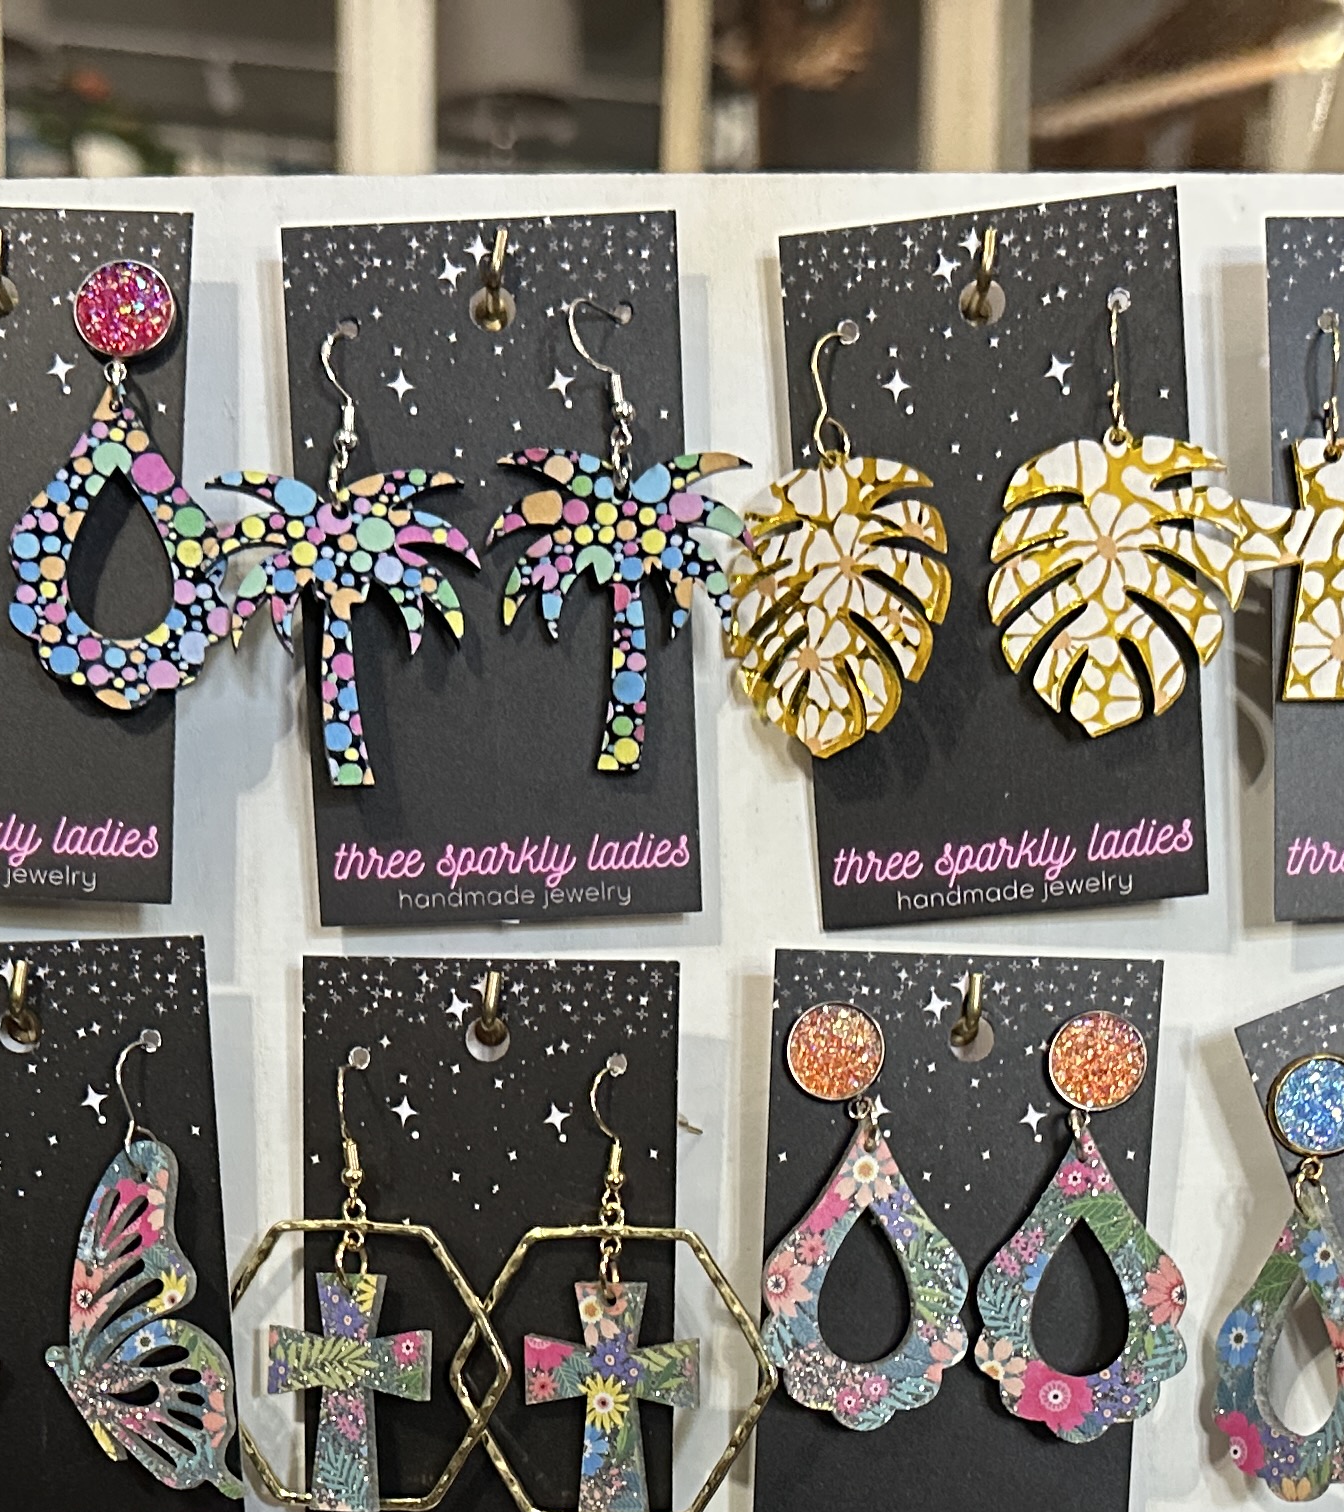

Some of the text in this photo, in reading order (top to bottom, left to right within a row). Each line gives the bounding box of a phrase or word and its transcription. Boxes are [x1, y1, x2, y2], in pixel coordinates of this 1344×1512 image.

[53, 816, 158, 858] ladies
[833, 818, 1194, 887] three sparkly ladies
[4, 865, 98, 892] jewelry
[334, 832, 690, 889] three sparkly ladies
[398, 881, 632, 910] handmade jewelry
[897, 871, 1133, 911] handmade jewelry
